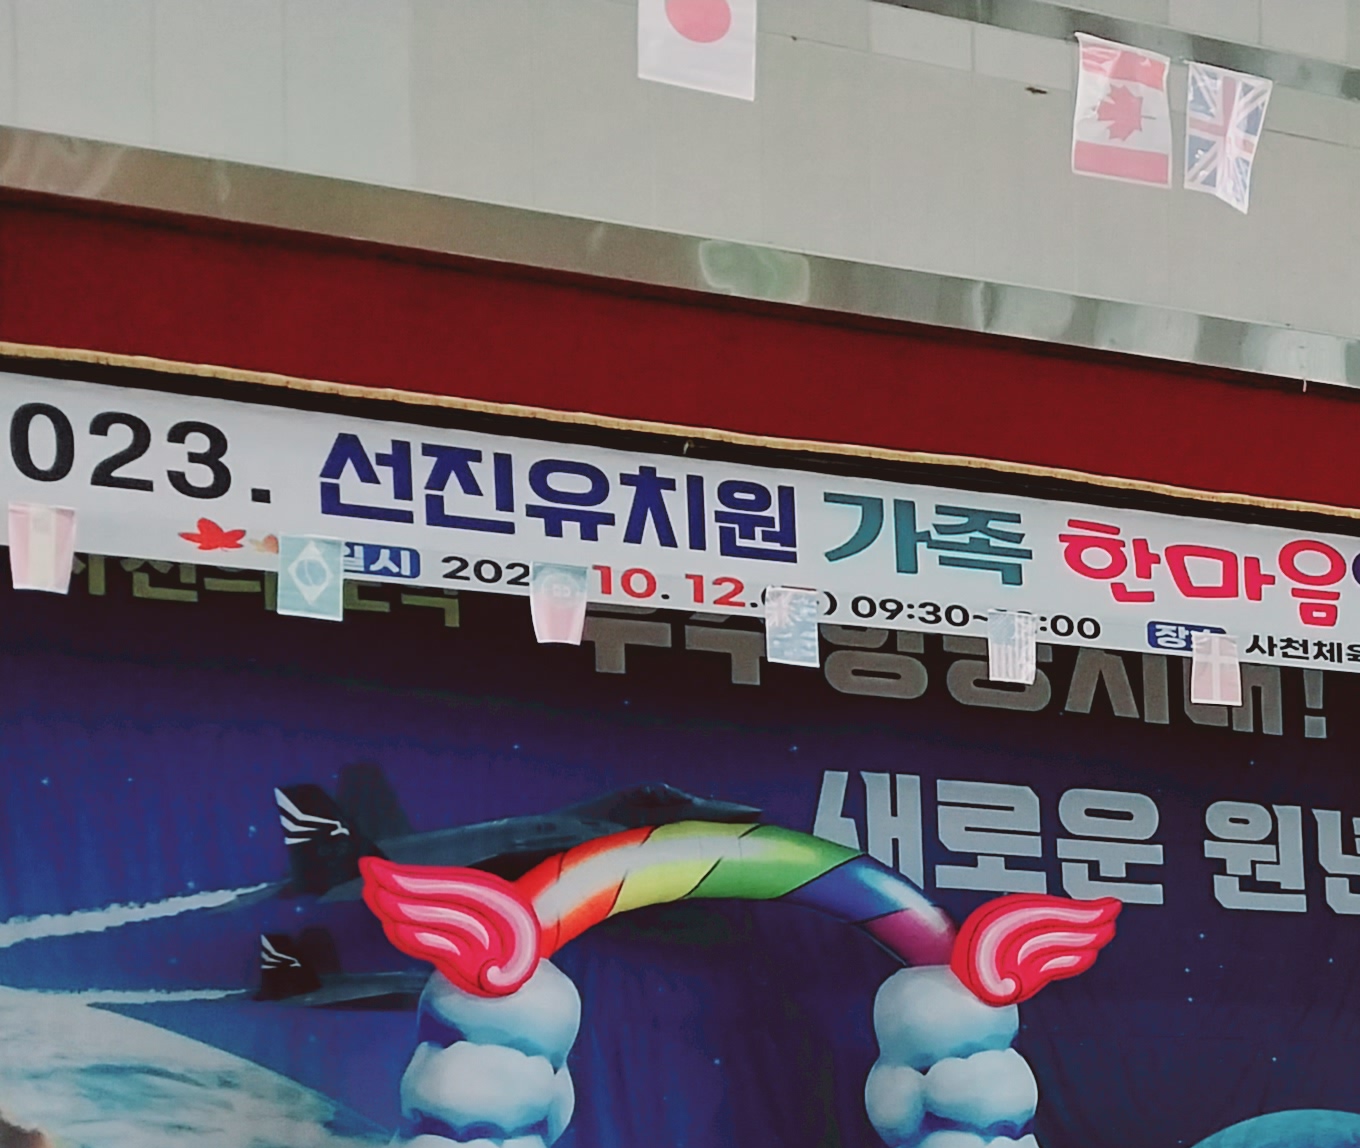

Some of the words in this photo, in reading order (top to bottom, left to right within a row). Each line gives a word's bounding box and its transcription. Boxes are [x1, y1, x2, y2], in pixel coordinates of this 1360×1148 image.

[319, 431, 798, 564] 선진유치원
[822, 496, 1034, 588] 가족
[812, 769, 1164, 905] 새로운
